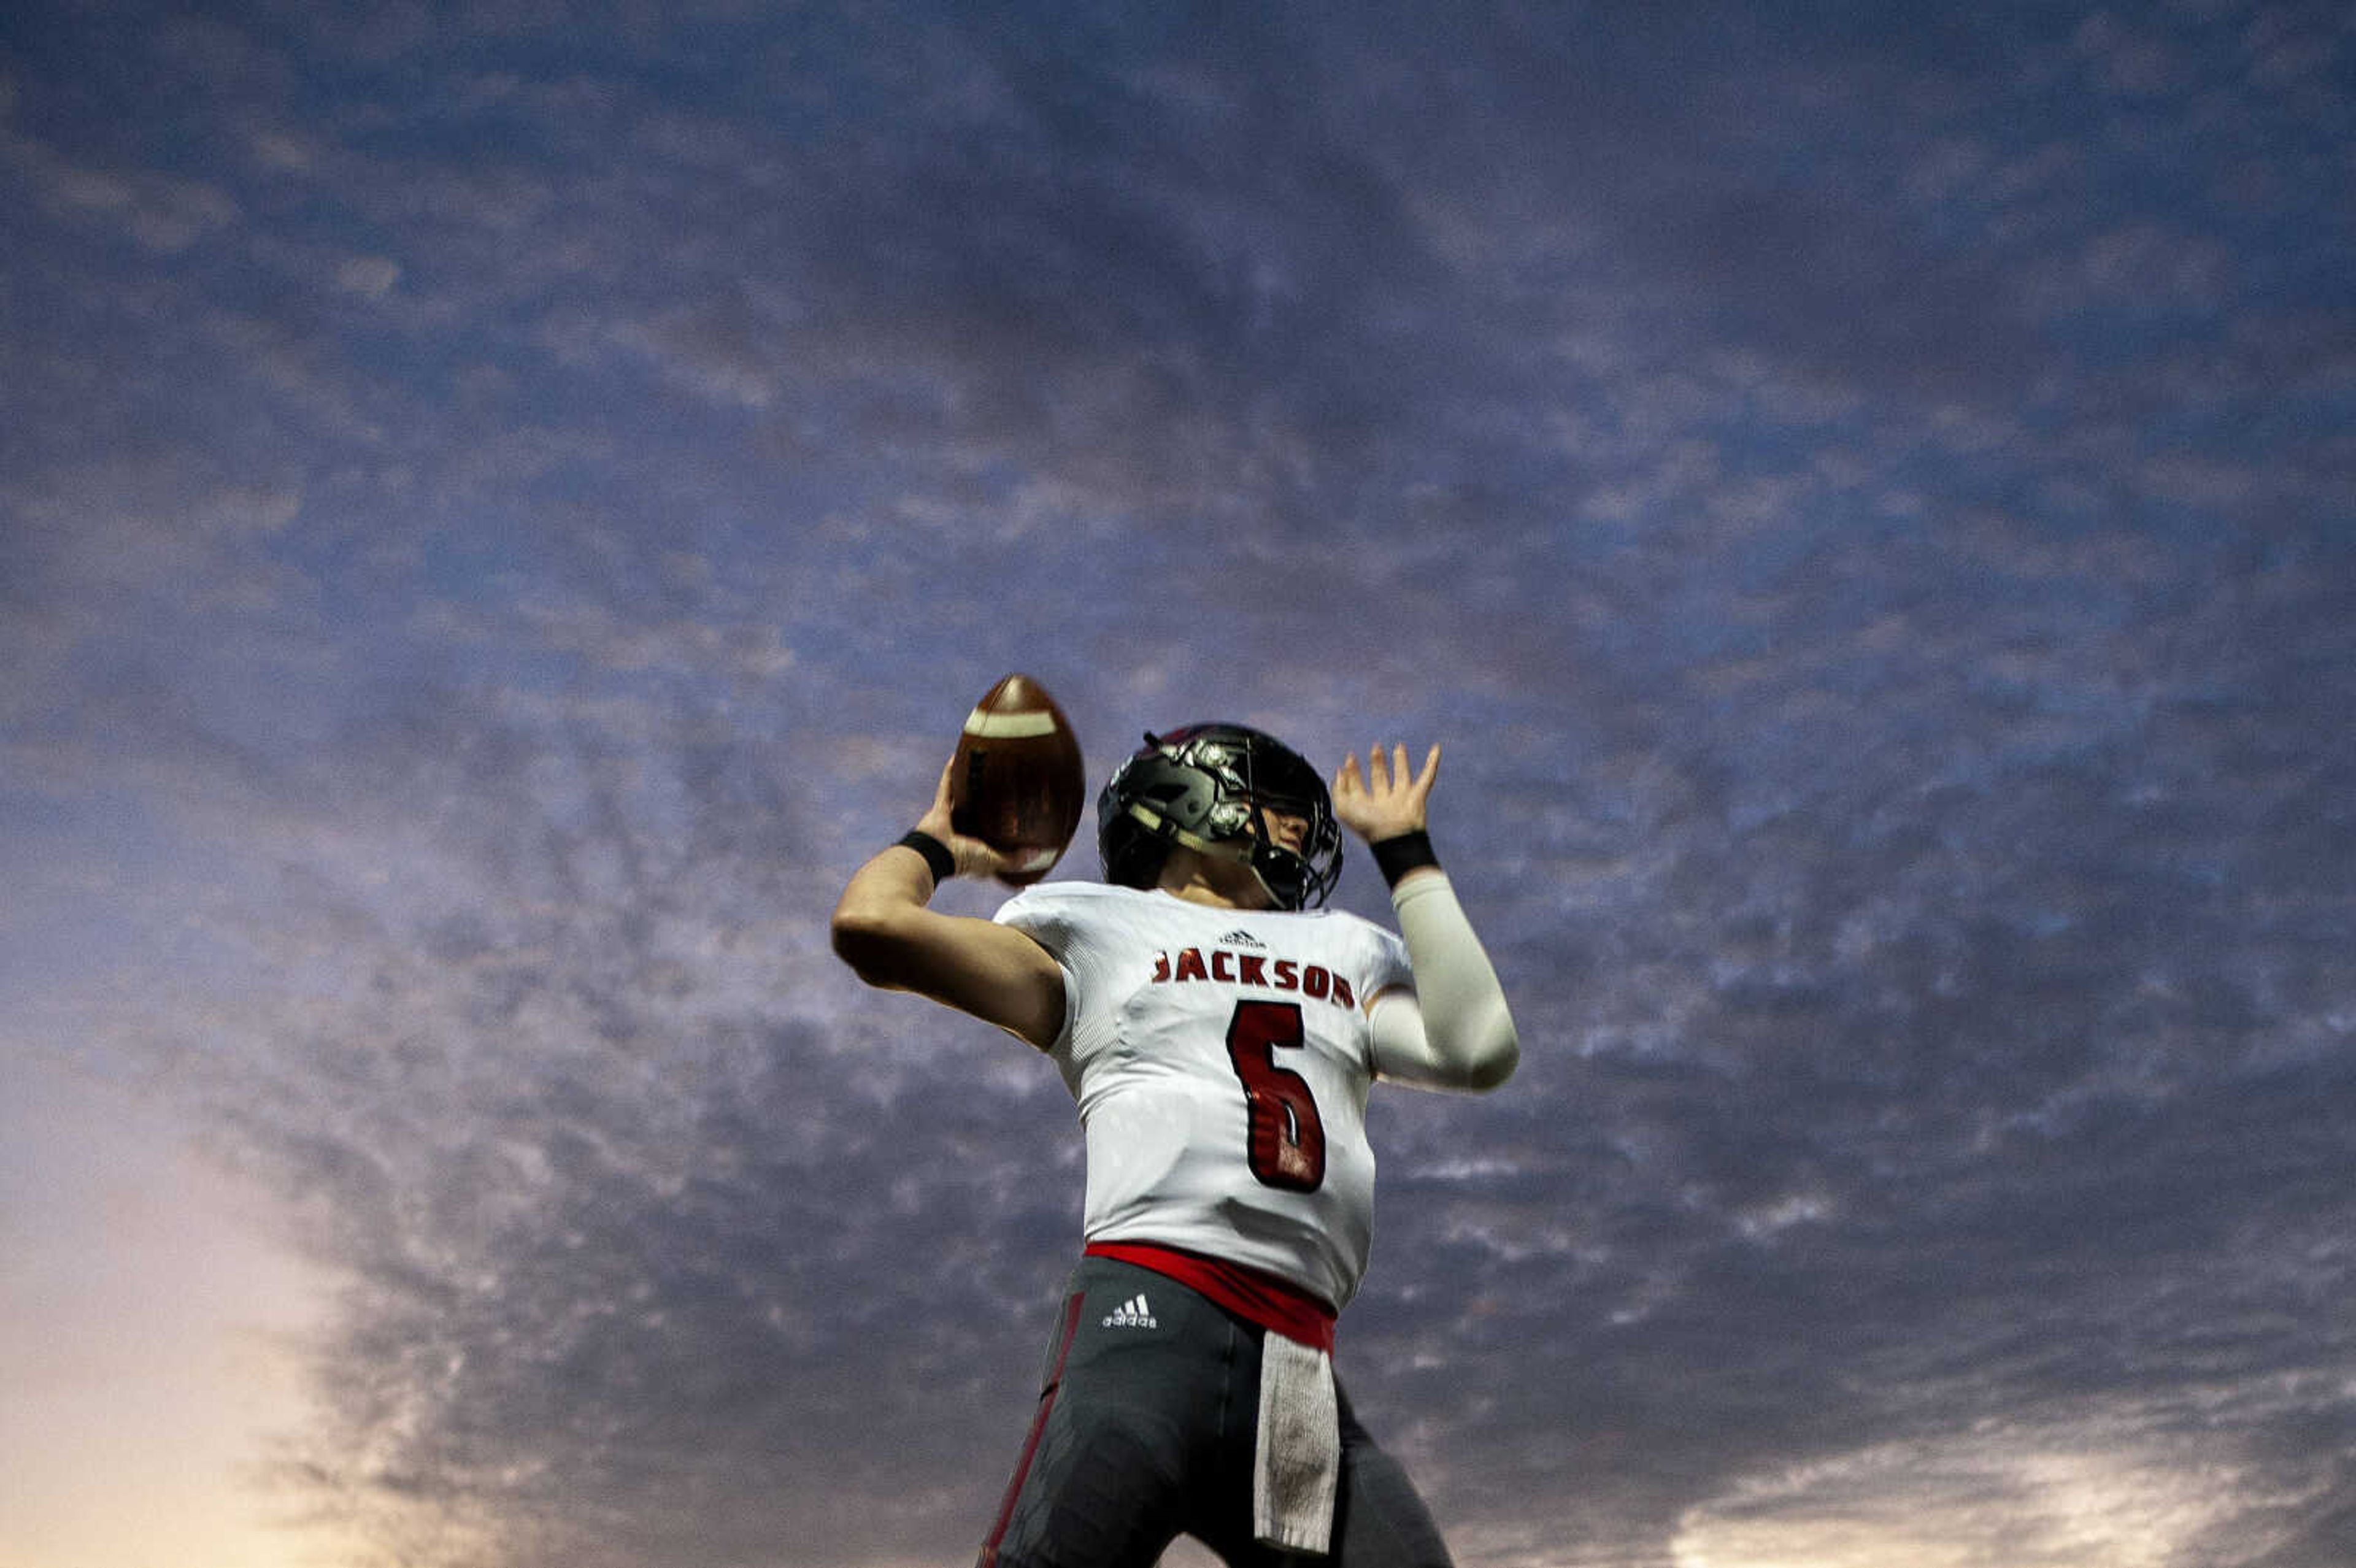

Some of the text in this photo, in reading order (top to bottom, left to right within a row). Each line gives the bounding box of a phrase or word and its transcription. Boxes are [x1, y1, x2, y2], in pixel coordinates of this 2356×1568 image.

[1152, 947, 1355, 1010] JACKSON
[1226, 999, 1326, 1193] 6
[1103, 1312, 1157, 1329] adidas
